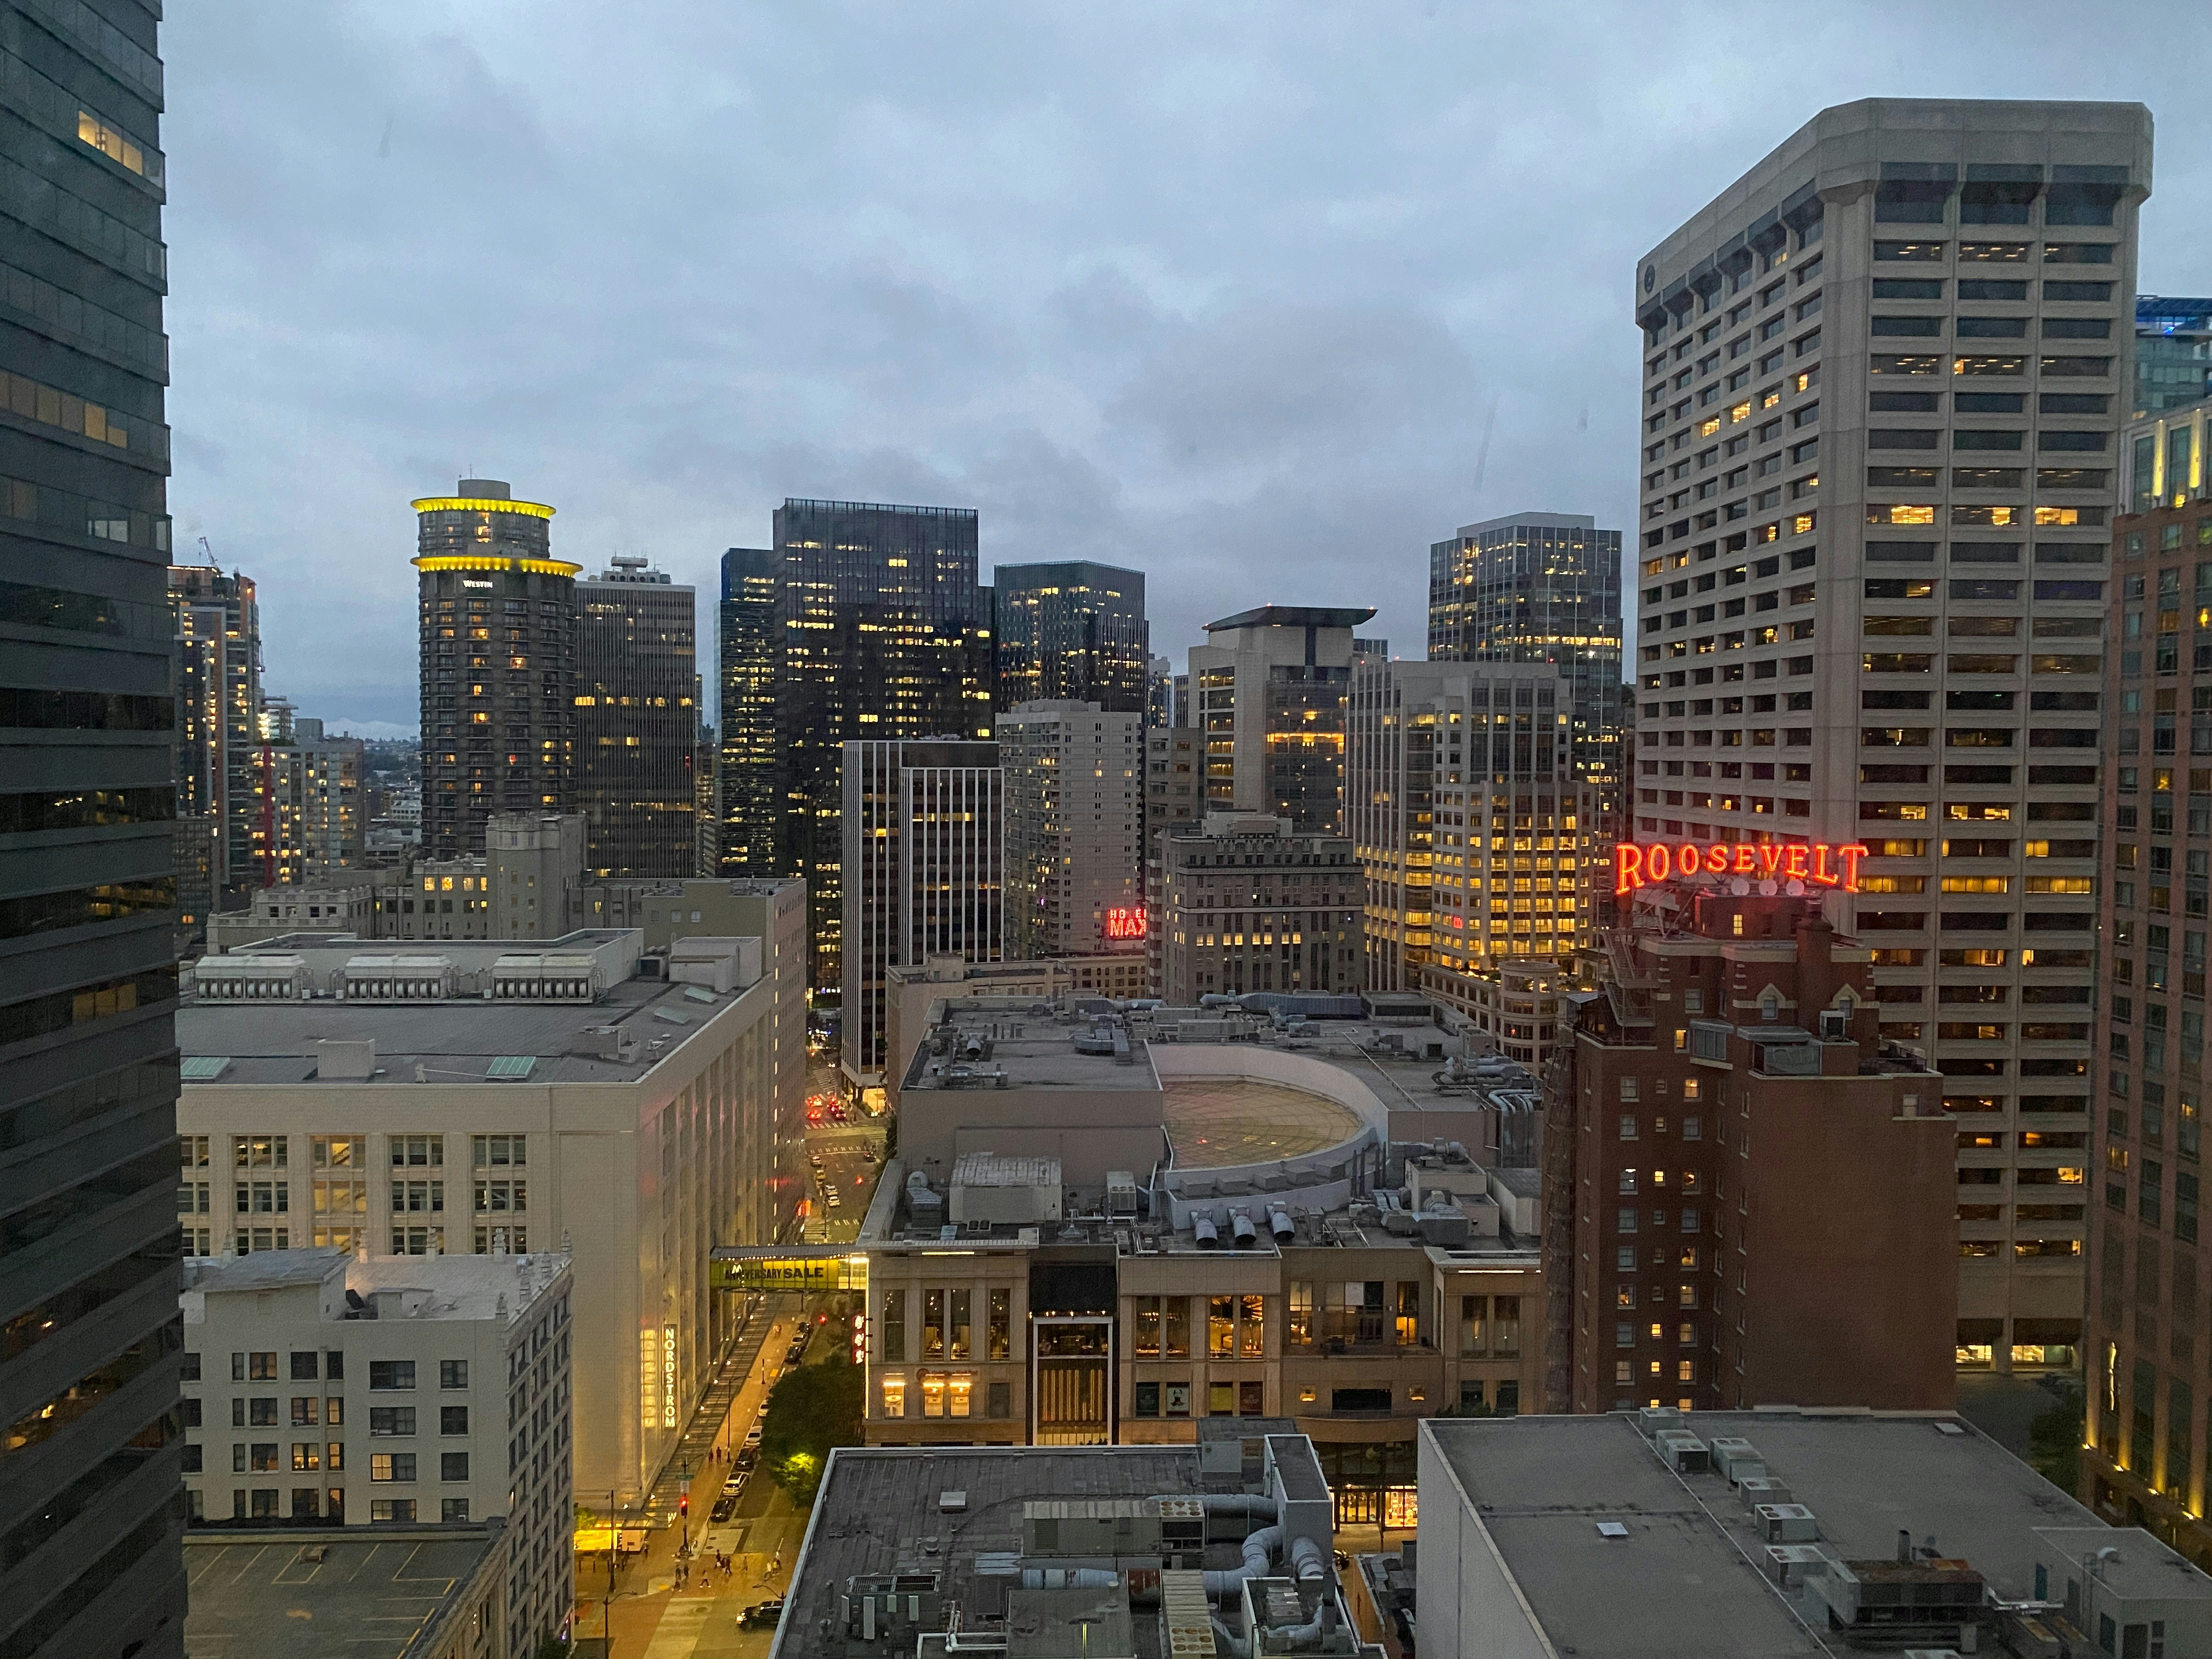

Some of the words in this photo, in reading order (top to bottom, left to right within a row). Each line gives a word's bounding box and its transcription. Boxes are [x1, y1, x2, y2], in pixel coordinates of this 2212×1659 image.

[463, 580, 493, 588] WESTIN
[1616, 843, 1869, 895] ROOSEVELT
[1110, 909, 1147, 919] HOE
[1109, 919, 1147, 936] MAX
[725, 1268, 782, 1279] ANNVERSARY
[783, 1267, 823, 1279] SALE
[664, 1328, 675, 1427] NORDSTROM
